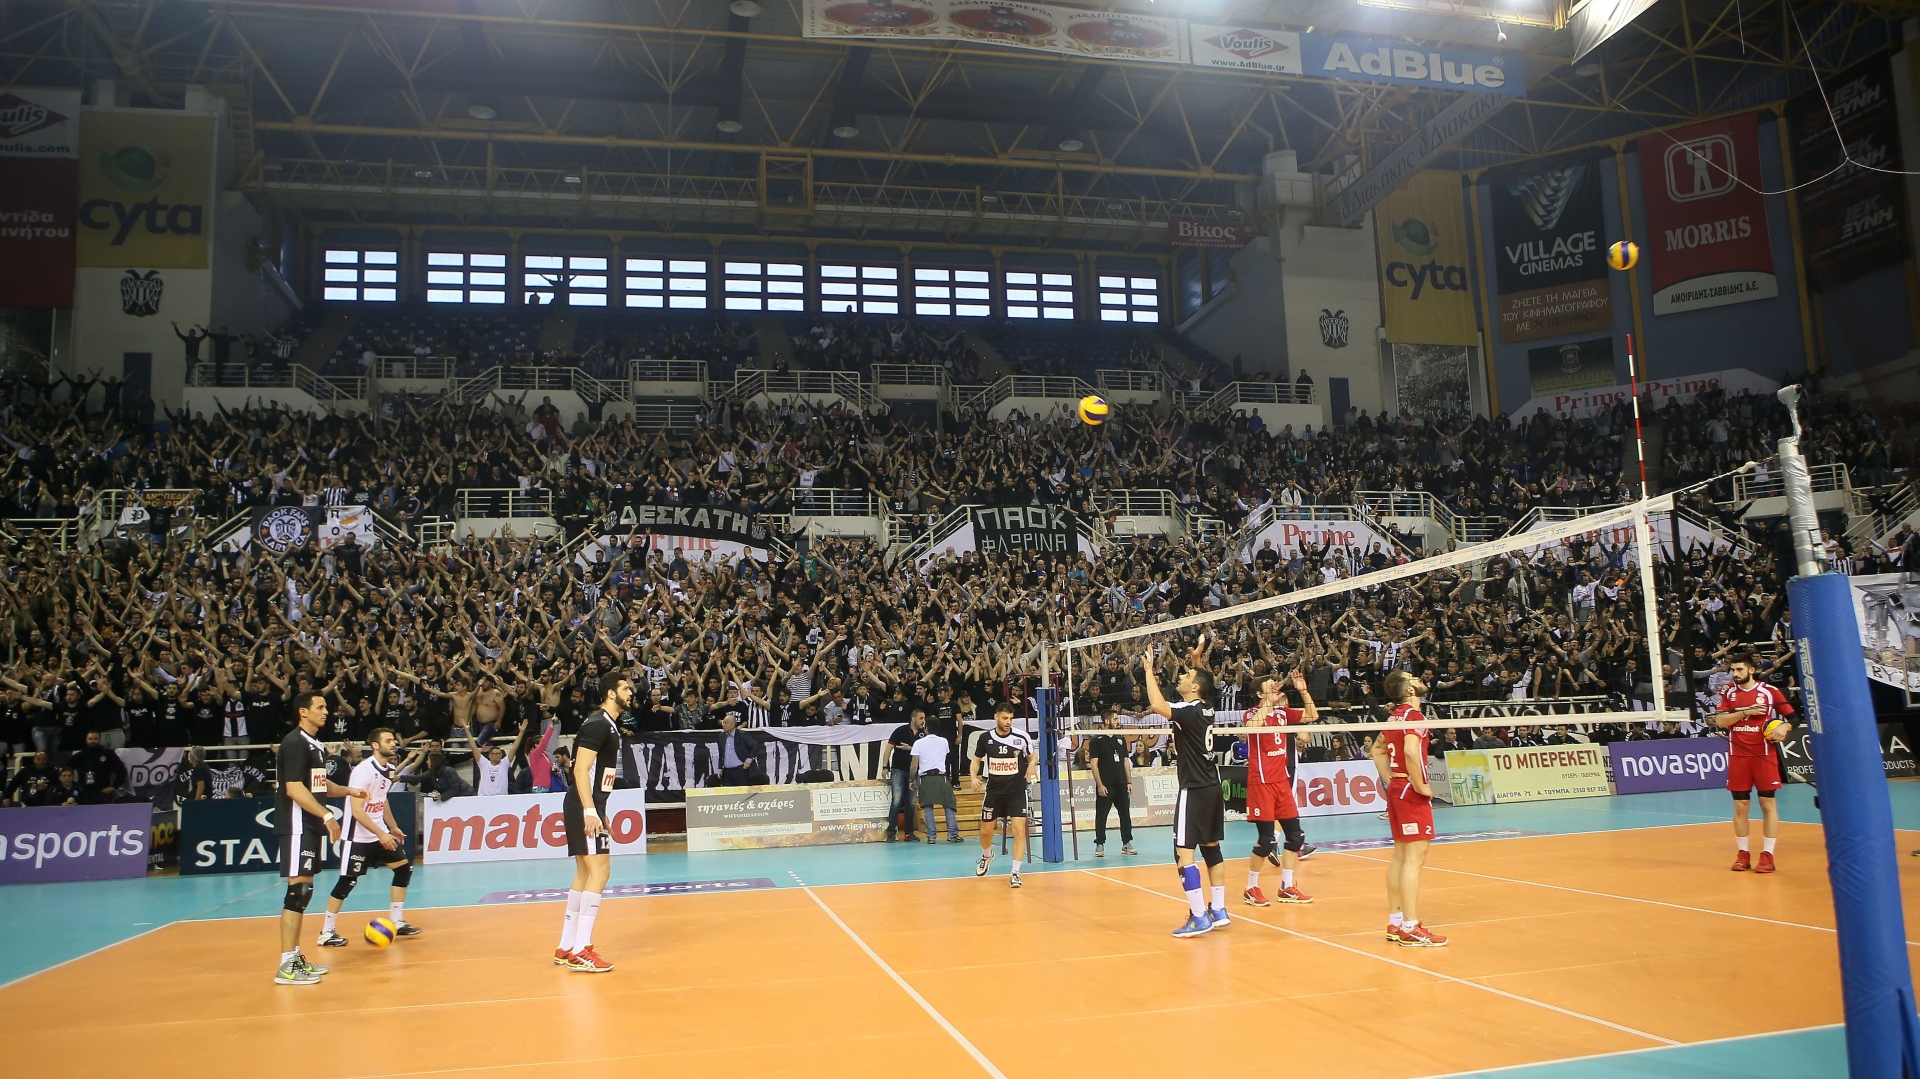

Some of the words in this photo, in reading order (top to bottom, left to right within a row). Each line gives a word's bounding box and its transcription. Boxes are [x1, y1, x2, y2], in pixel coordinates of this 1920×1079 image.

[1221, 35, 1273, 53] Voulis
[1212, 58, 1286, 71] www.AdBlue.gr
[1323, 42, 1505, 88] AdBlue
[79, 196, 203, 246] cyta
[1177, 221, 1236, 241] Βίκος
[1665, 215, 1751, 251] MORRIS
[1505, 231, 1596, 263] VILLAGE
[1519, 254, 1584, 276] CINEMAS
[1386, 259, 1468, 300] cyta
[1512, 295, 1541, 309] ΖΗΣΤΕ
[1545, 293, 1559, 303] ΤΗ
[1562, 287, 1598, 300] ΜΑΓΕΙΑ
[1503, 312, 1519, 322] ΤΟΥ
[1523, 298, 1609, 319] ΚΙΝΗΜΑΤΟΓΡΑΦΟΥ
[1516, 322, 1531, 332] ΜΕ
[1555, 391, 1626, 412] Prime
[262, 508, 288, 527] PAOK
[290, 508, 310, 527] FANS
[620, 505, 749, 535] ΔΕΣΚΑΤΗ
[976, 507, 1067, 530] ΠΑΟΚ
[264, 535, 307, 553] LARNCA
[1282, 523, 1356, 547] Prime
[1205, 724, 1214, 751] 6
[1274, 732, 1282, 745] 8
[998, 745, 1008, 755] 16
[1387, 742, 1399, 767] 2
[1493, 755, 1512, 771] ΤΟ
[1517, 749, 1599, 770] ΜΠΕΡΕΚΕΤΙ
[990, 760, 1018, 774] mateco
[1621, 751, 1729, 780] novaspo
[380, 779, 386, 790] 3
[697, 801, 746, 813] τηγανιές
[747, 800, 756, 809] &
[758, 798, 795, 811] σχάρες
[819, 790, 891, 805] DELIVERY
[1253, 807, 1261, 817] 8
[427, 804, 643, 852] mateo
[304, 858, 313, 872] 4
[353, 861, 362, 872] 3
